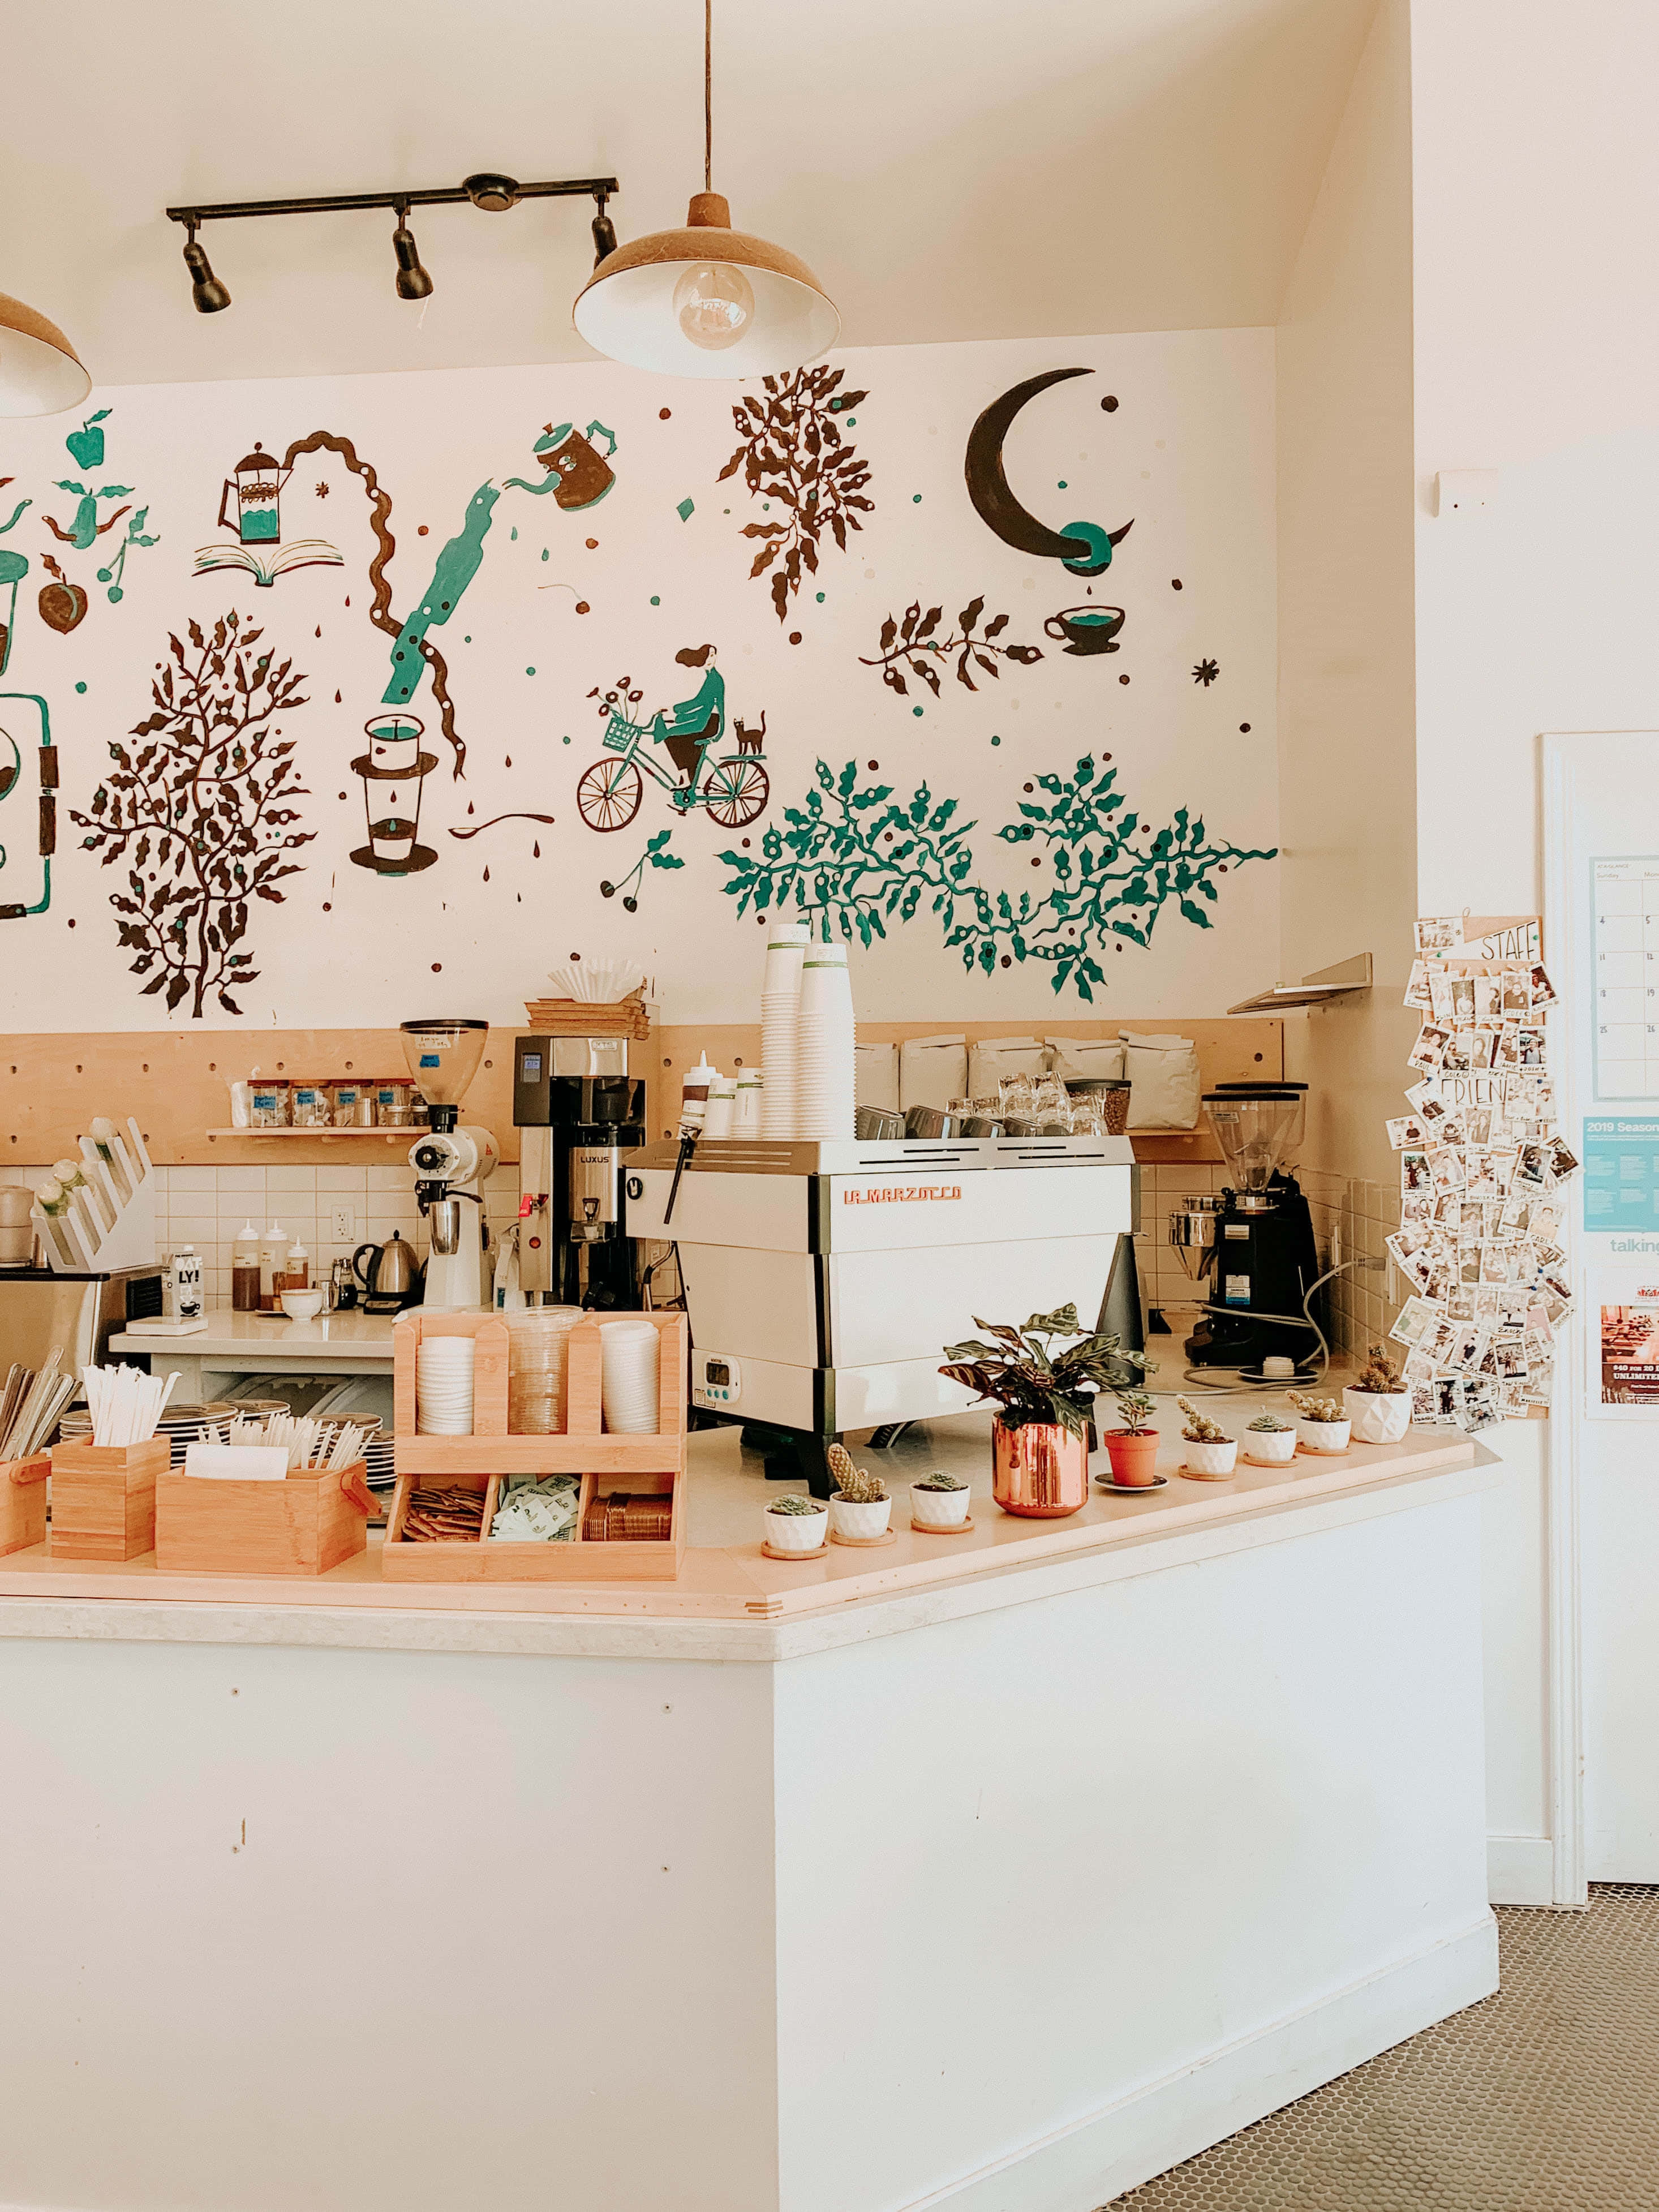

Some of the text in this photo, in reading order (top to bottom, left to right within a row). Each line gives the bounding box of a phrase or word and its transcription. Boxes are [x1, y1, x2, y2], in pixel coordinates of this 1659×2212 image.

[1600, 916, 1651, 925] 4 5
[1481, 921, 1536, 960] STAFF
[1415, 1060, 1430, 1071] PAUL
[1587, 1122, 1614, 1132] 2019
[179, 1270, 199, 1283] LY!
